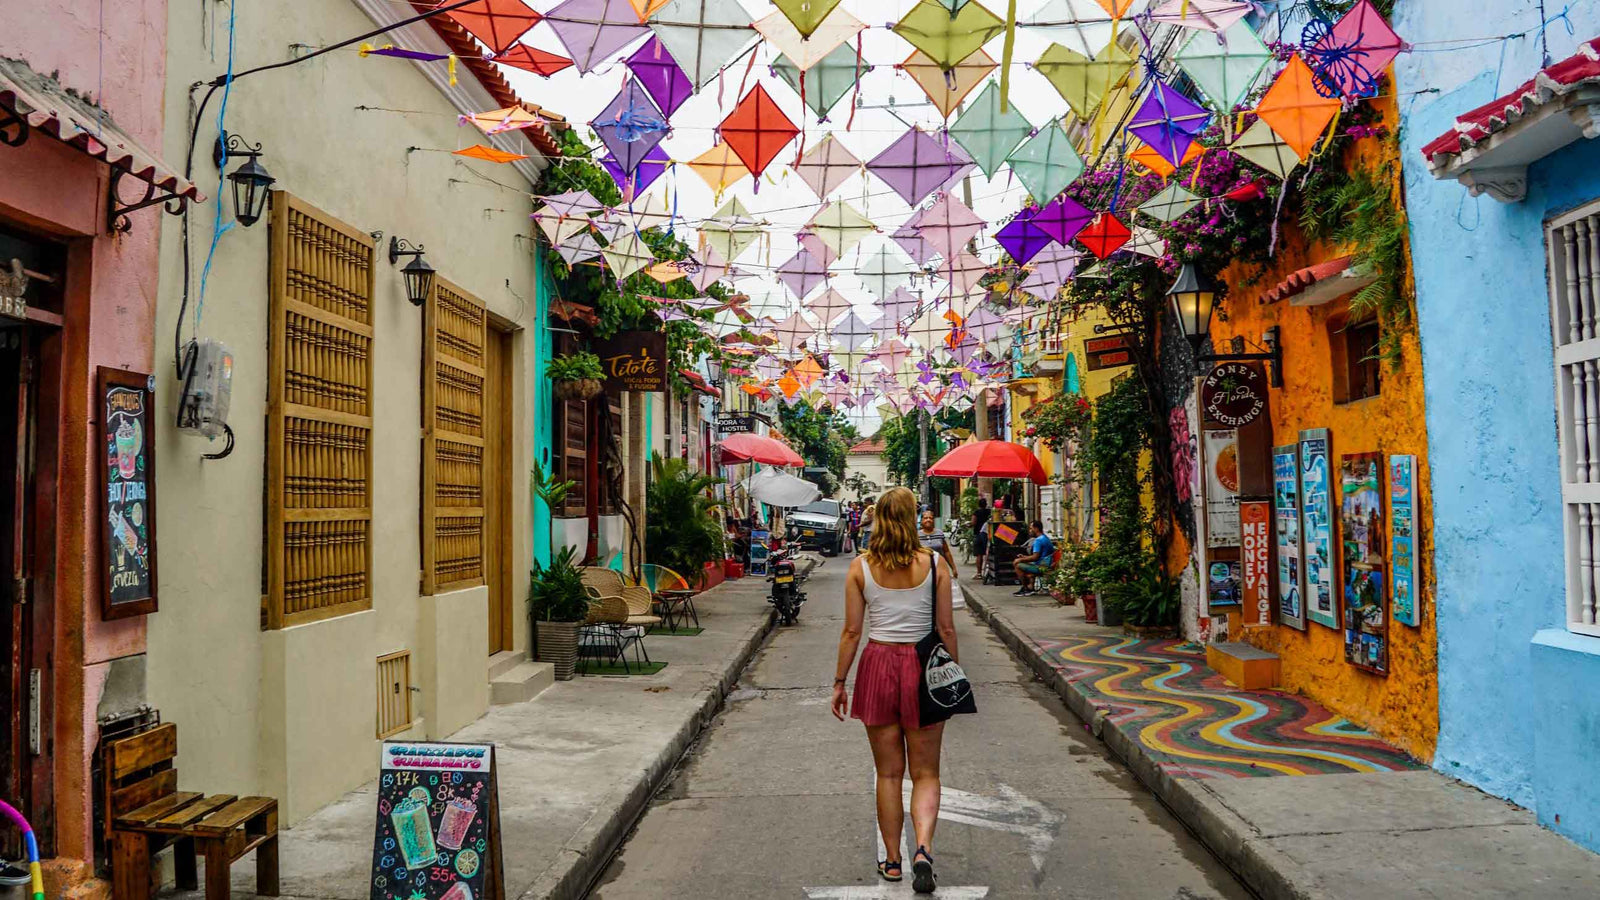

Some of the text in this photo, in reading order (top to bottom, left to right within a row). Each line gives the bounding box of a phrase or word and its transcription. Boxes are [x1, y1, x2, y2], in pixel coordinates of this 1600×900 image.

[604, 354, 659, 378] Titoté
[1207, 365, 1257, 387] MONEY
[1211, 385, 1260, 405] Florida
[1208, 400, 1264, 425] EXCHANGE
[1243, 522, 1256, 590] MONEY
[1257, 522, 1270, 625] EXCHANGE
